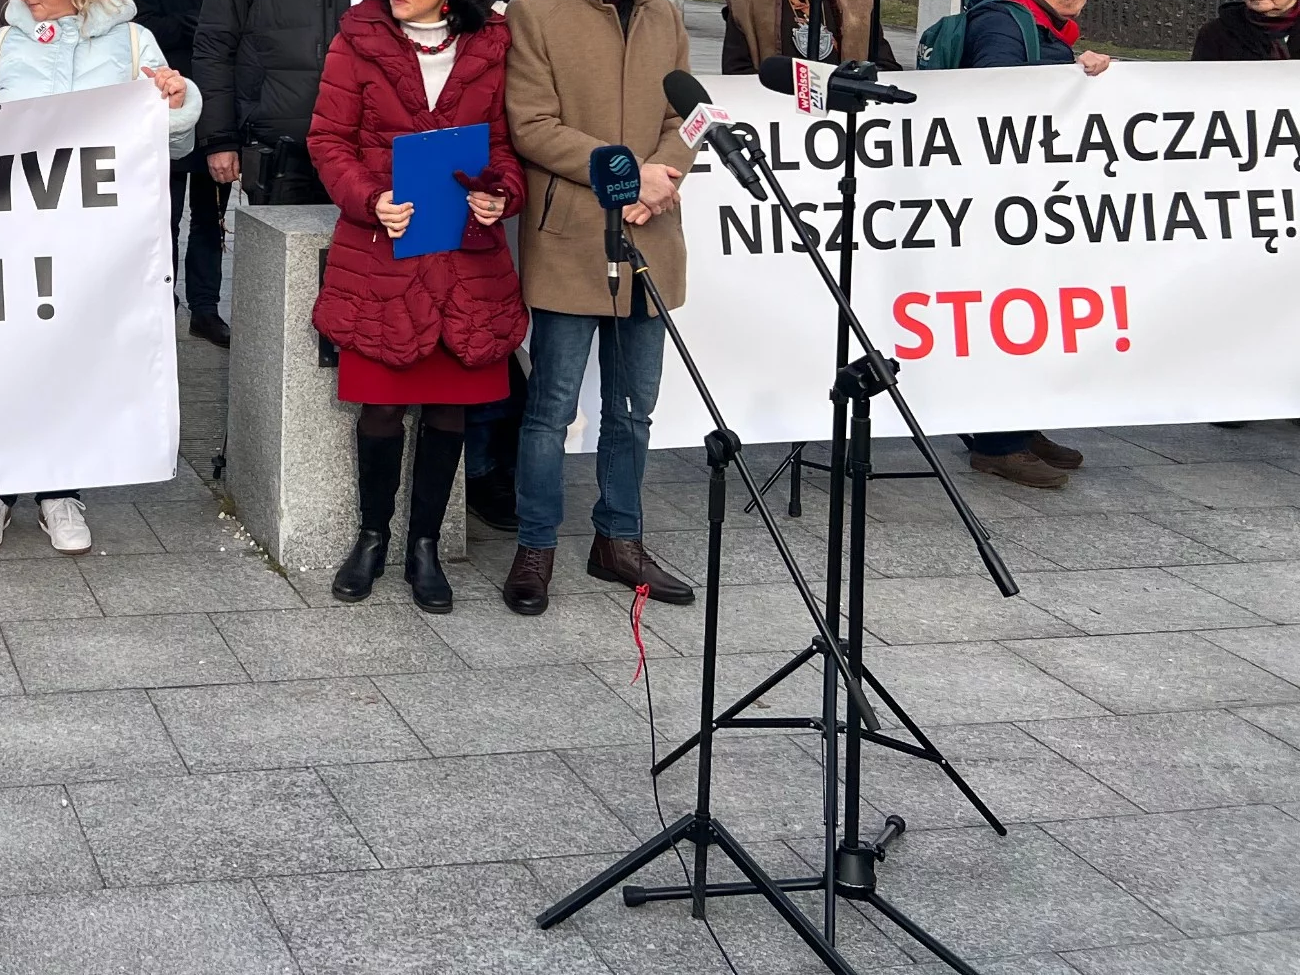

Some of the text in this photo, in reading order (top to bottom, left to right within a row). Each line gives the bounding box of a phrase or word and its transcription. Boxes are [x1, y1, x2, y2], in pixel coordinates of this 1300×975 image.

[798, 66, 809, 109] wPolsce
[689, 116, 959, 174] LOGIA
[606, 179, 640, 195] polsat
[611, 190, 637, 202] news
[718, 180, 1297, 256] NISZCZY OŚWIATĘ!
[34, 256, 55, 321] !
[892, 285, 1131, 361] STOP!
